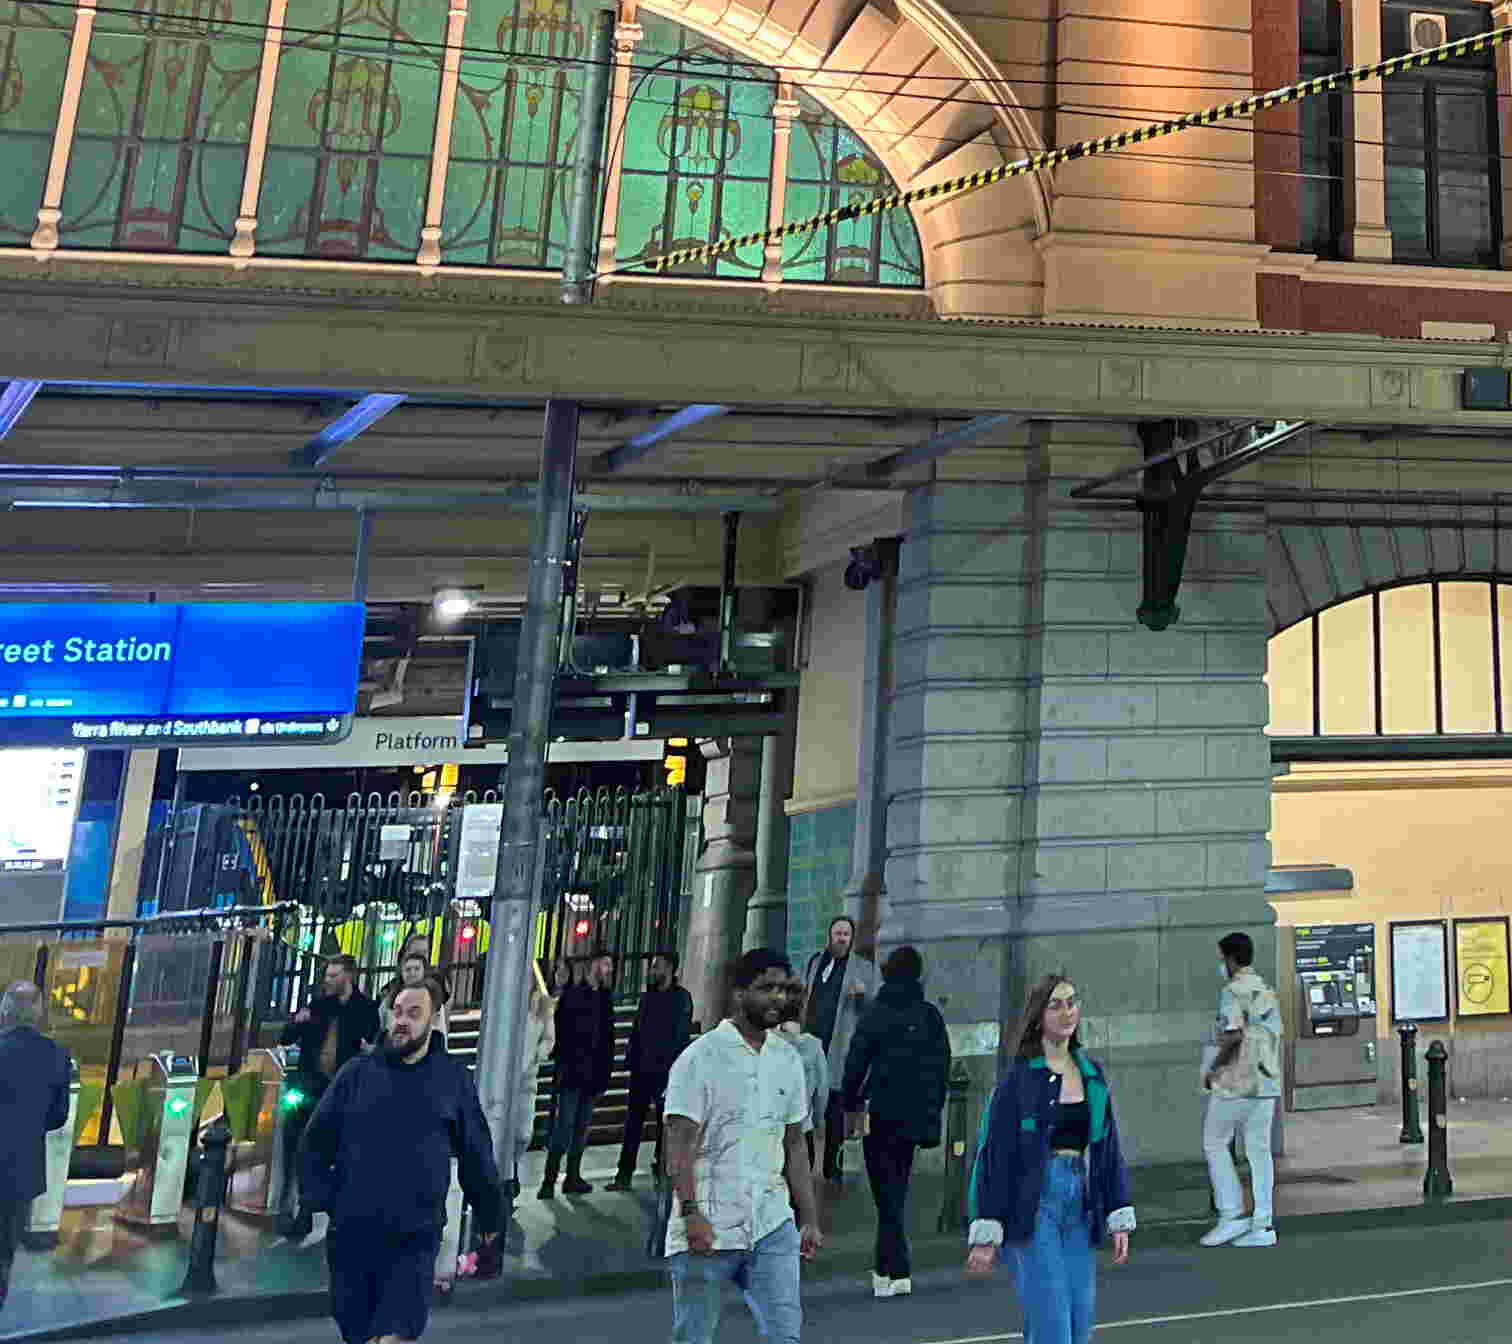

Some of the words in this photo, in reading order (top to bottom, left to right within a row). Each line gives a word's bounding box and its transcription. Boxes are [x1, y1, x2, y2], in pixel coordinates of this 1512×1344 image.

[64, 636, 171, 663] Station
[145, 722, 172, 735] and
[375, 732, 457, 750] Platform
